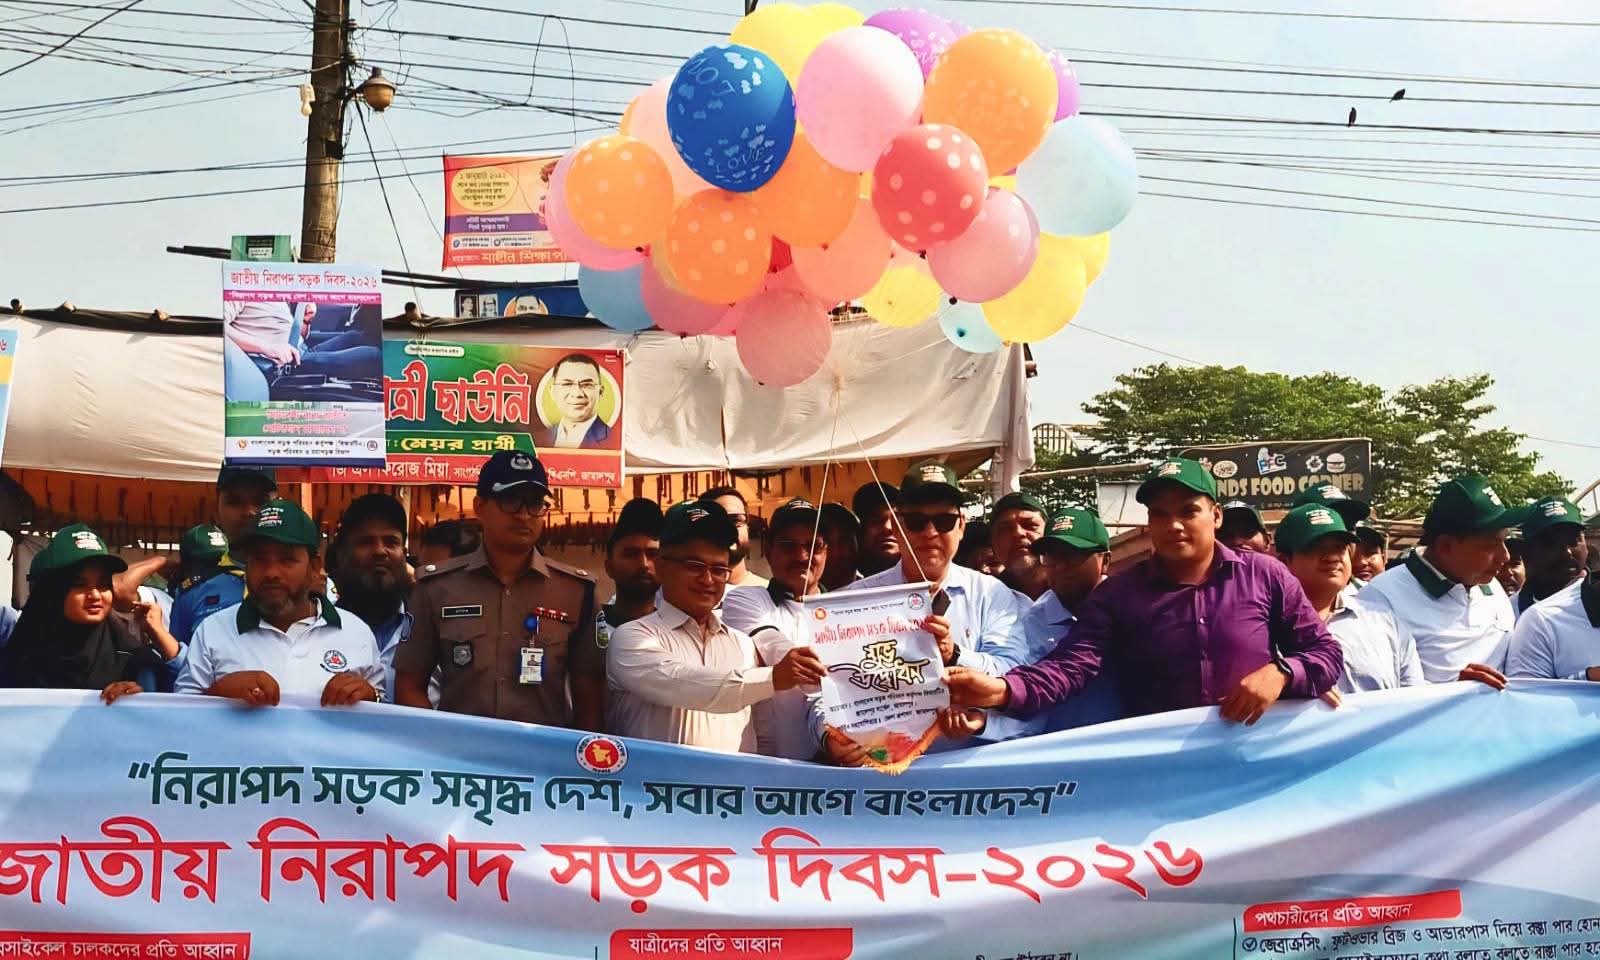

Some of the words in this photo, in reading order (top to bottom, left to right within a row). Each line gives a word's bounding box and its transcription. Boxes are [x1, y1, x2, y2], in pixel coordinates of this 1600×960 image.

[384, 360, 428, 422] াত্রী
[433, 363, 531, 425] ছাউনি
[401, 437, 464, 451] মেয়র
[1250, 476, 1295, 497] FOOD
[312, 766, 424, 815] সড়ক
[431, 769, 535, 827] সমৃদ্ধ
[544, 777, 633, 820] দেশ,
[643, 781, 746, 820] সবার
[752, 786, 856, 817] আগে
[0, 815, 232, 905] জাতীয়
[247, 817, 526, 904] নিরাপদ
[541, 844, 737, 914] সড়ক
[752, 826, 1204, 905] দিবস-২০২৬
[1254, 905, 1329, 926] পথচারীদের
[1332, 902, 1365, 922] প্রতি
[1383, 925, 1407, 946] ব্রিজ
[1412, 928, 1422, 942] ও
[1425, 924, 1490, 942] আন্ডারপাস
[1493, 918, 1522, 938] দিয়ে
[1552, 918, 1573, 935] পার
[70, 941, 141, 959] চালকদের
[146, 939, 180, 959] প্রতি
[628, 933, 690, 954] যাত্রীদের
[694, 933, 727, 954] প্রতি
[1561, 942, 1581, 957] পার
